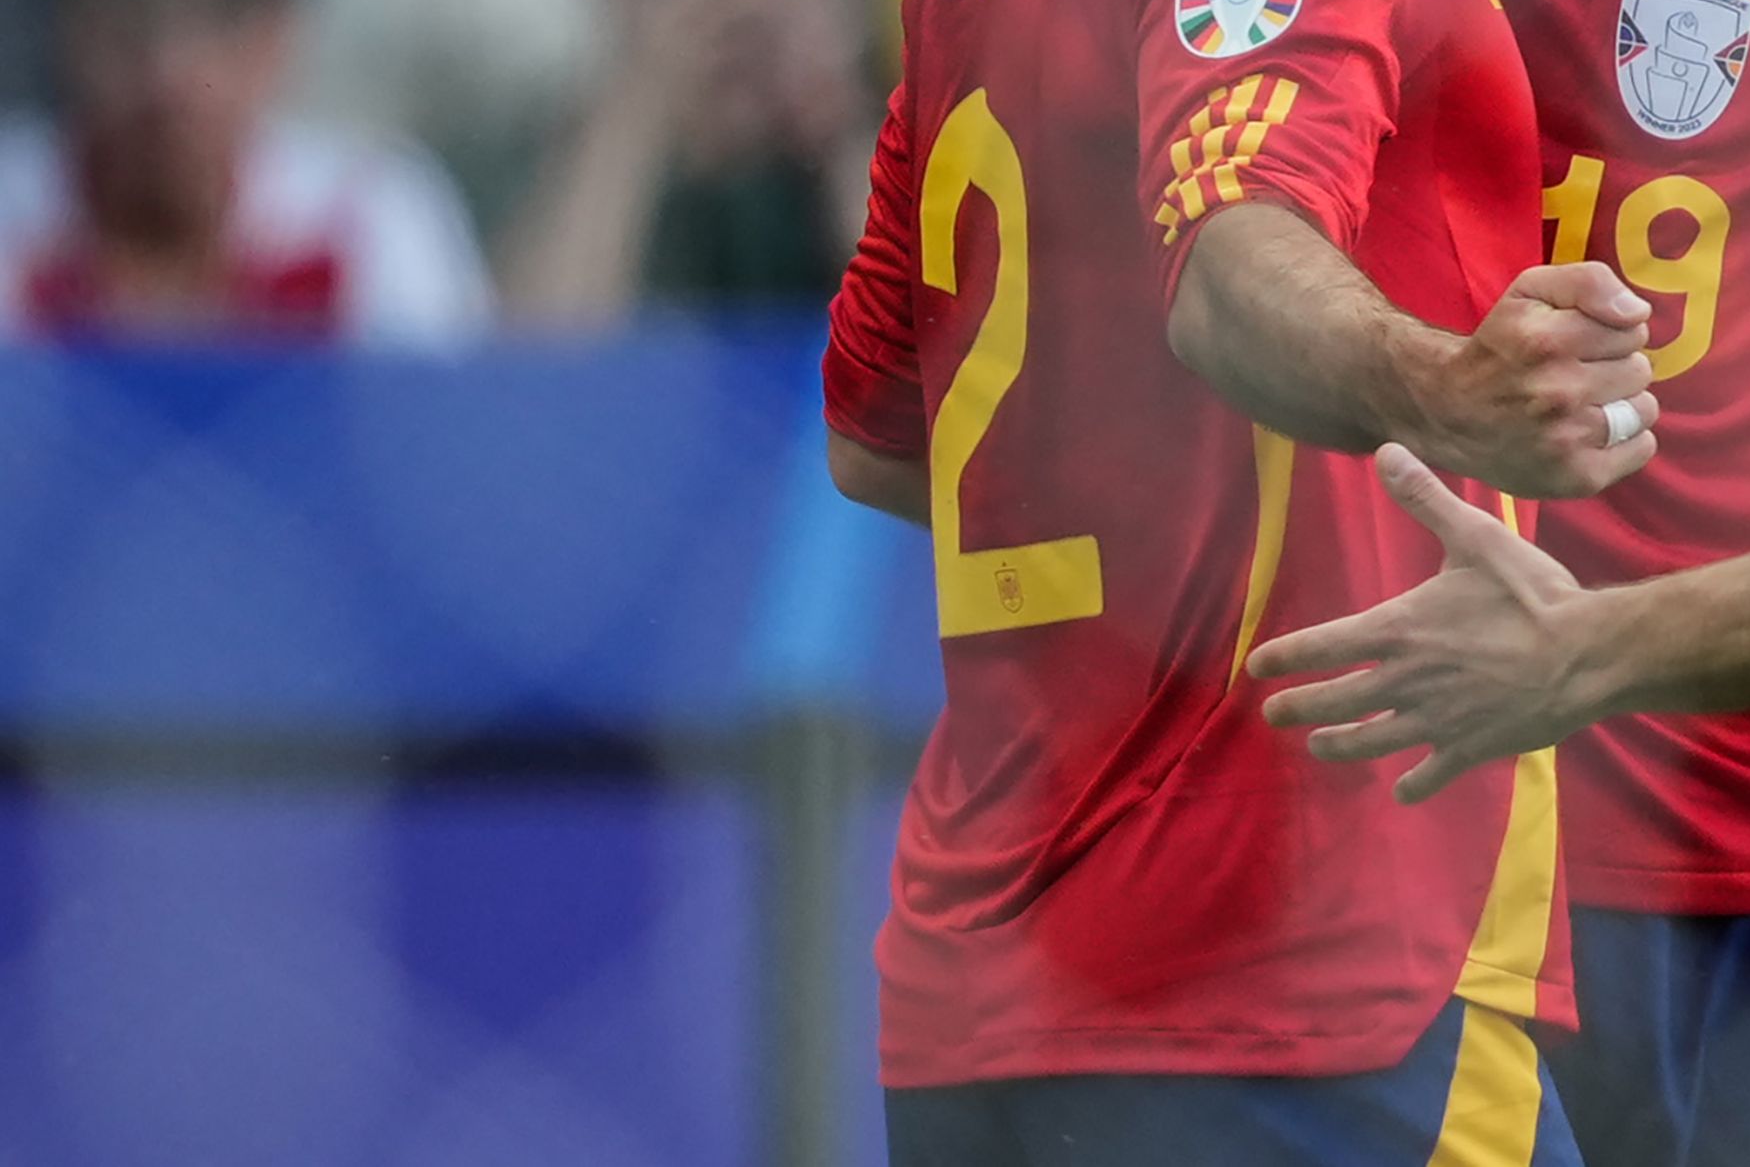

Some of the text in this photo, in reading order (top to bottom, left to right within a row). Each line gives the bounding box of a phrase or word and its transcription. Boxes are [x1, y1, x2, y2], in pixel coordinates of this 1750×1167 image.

[1637, 109, 1676, 132] WINNER
[919, 87, 1103, 637] 2
[1542, 154, 1731, 383] 19
